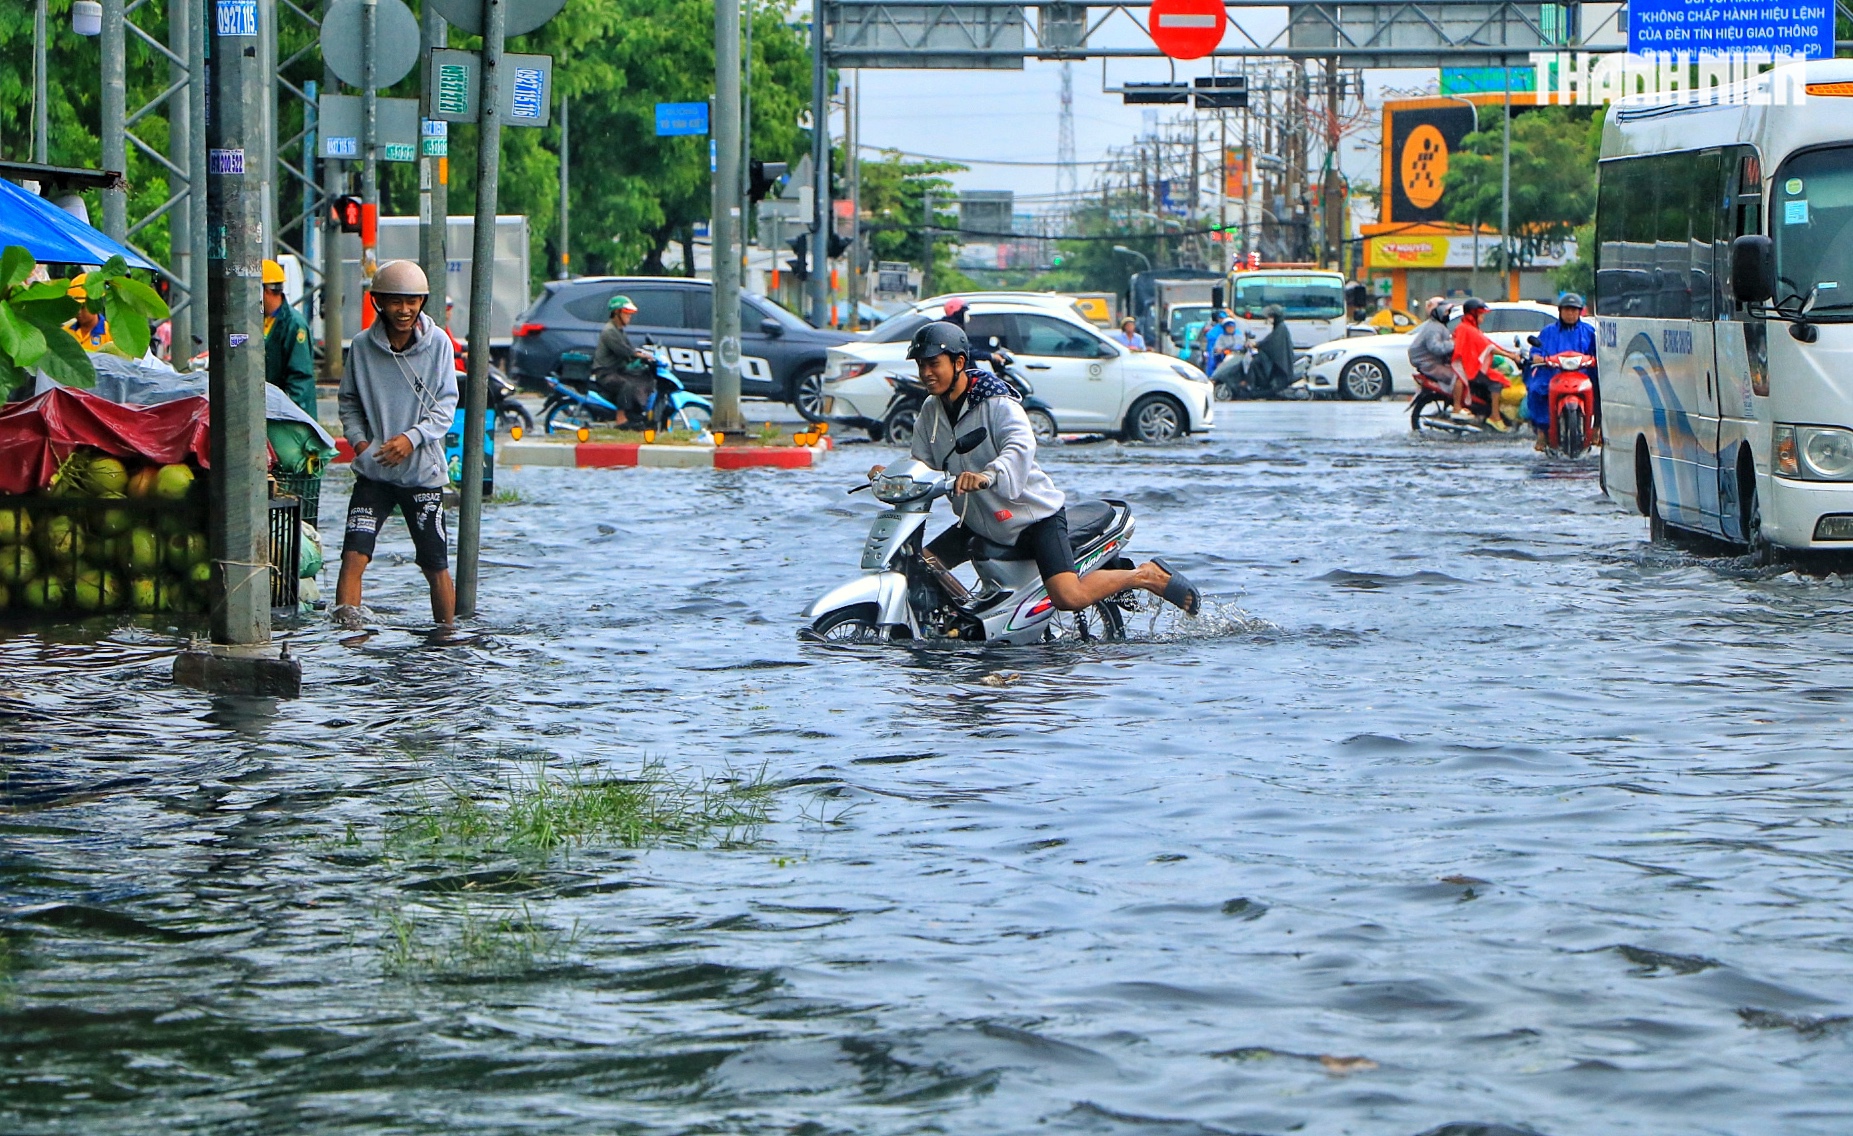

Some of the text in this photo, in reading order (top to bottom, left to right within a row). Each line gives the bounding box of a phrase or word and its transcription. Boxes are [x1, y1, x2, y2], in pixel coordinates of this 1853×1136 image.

[1687, 6, 1720, 22] CHẤP
[1723, 6, 1758, 21] HÀNH
[1761, 6, 1789, 22] HIỆU
[1792, 5, 1826, 20] LỆNH
[1638, 24, 1819, 41] CỦA ĐÈN TÍN HIỆU GIAO THÔNG
[1803, 43, 1822, 56] CP)
[412, 493, 441, 503] VERSACE
